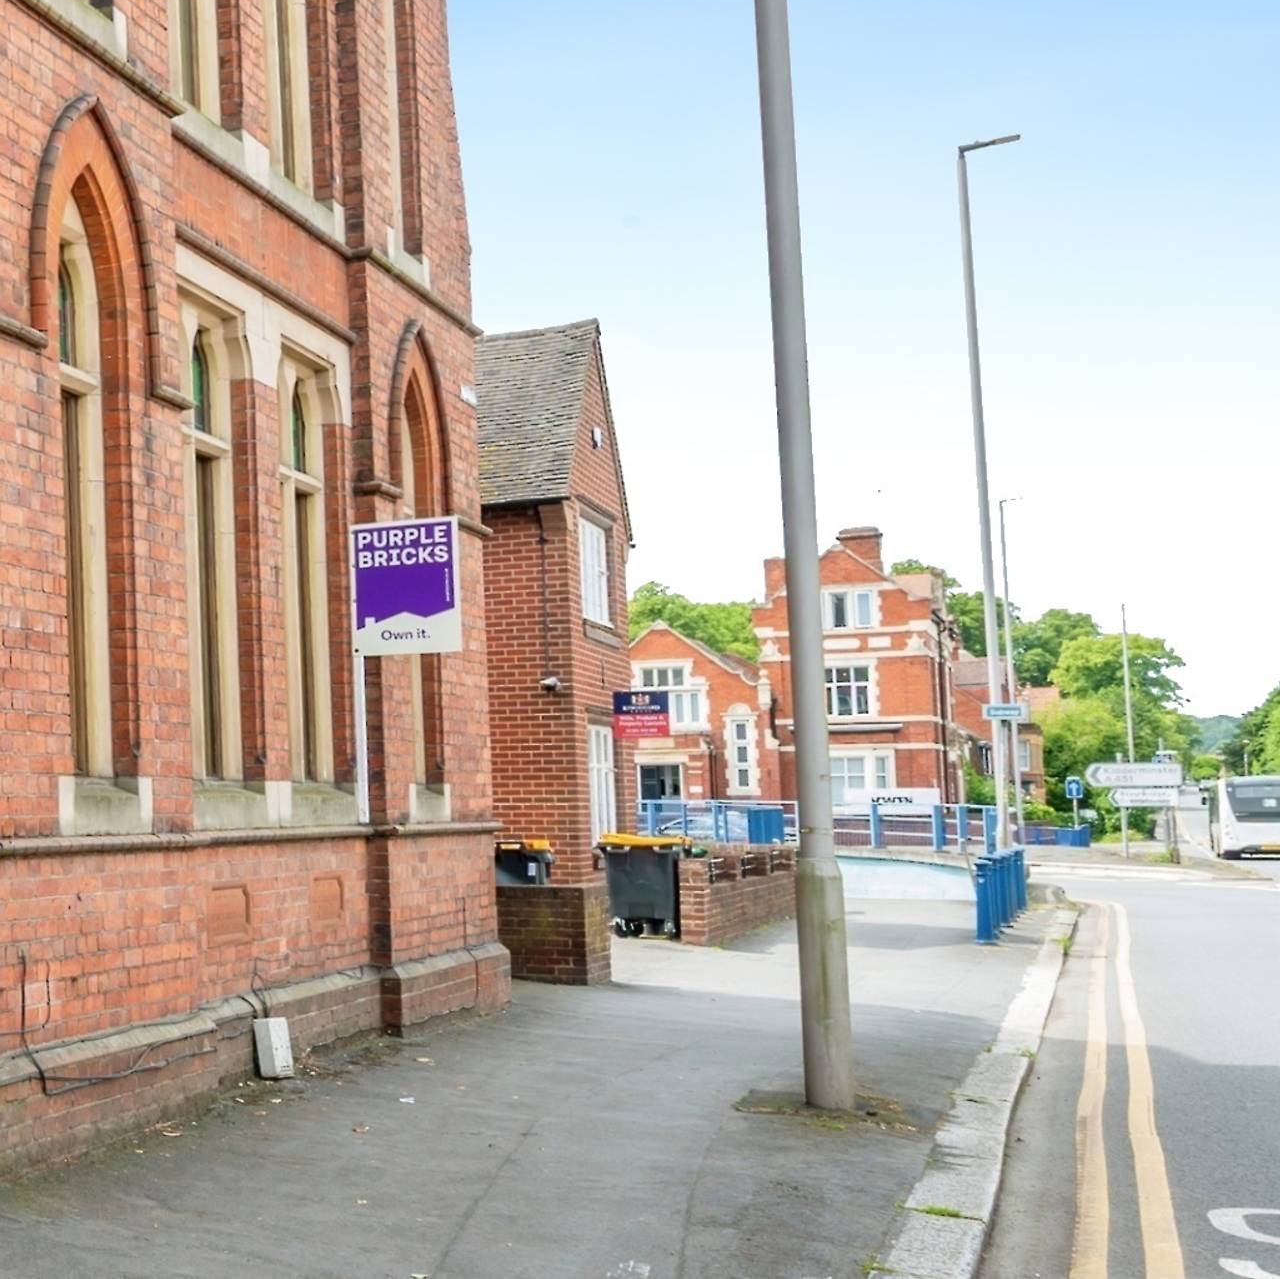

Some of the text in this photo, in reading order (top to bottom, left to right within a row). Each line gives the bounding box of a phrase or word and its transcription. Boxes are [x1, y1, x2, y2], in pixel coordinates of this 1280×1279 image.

[357, 525, 448, 550] PURPLE
[358, 545, 449, 569] BRICKS
[380, 629, 414, 641] Own
